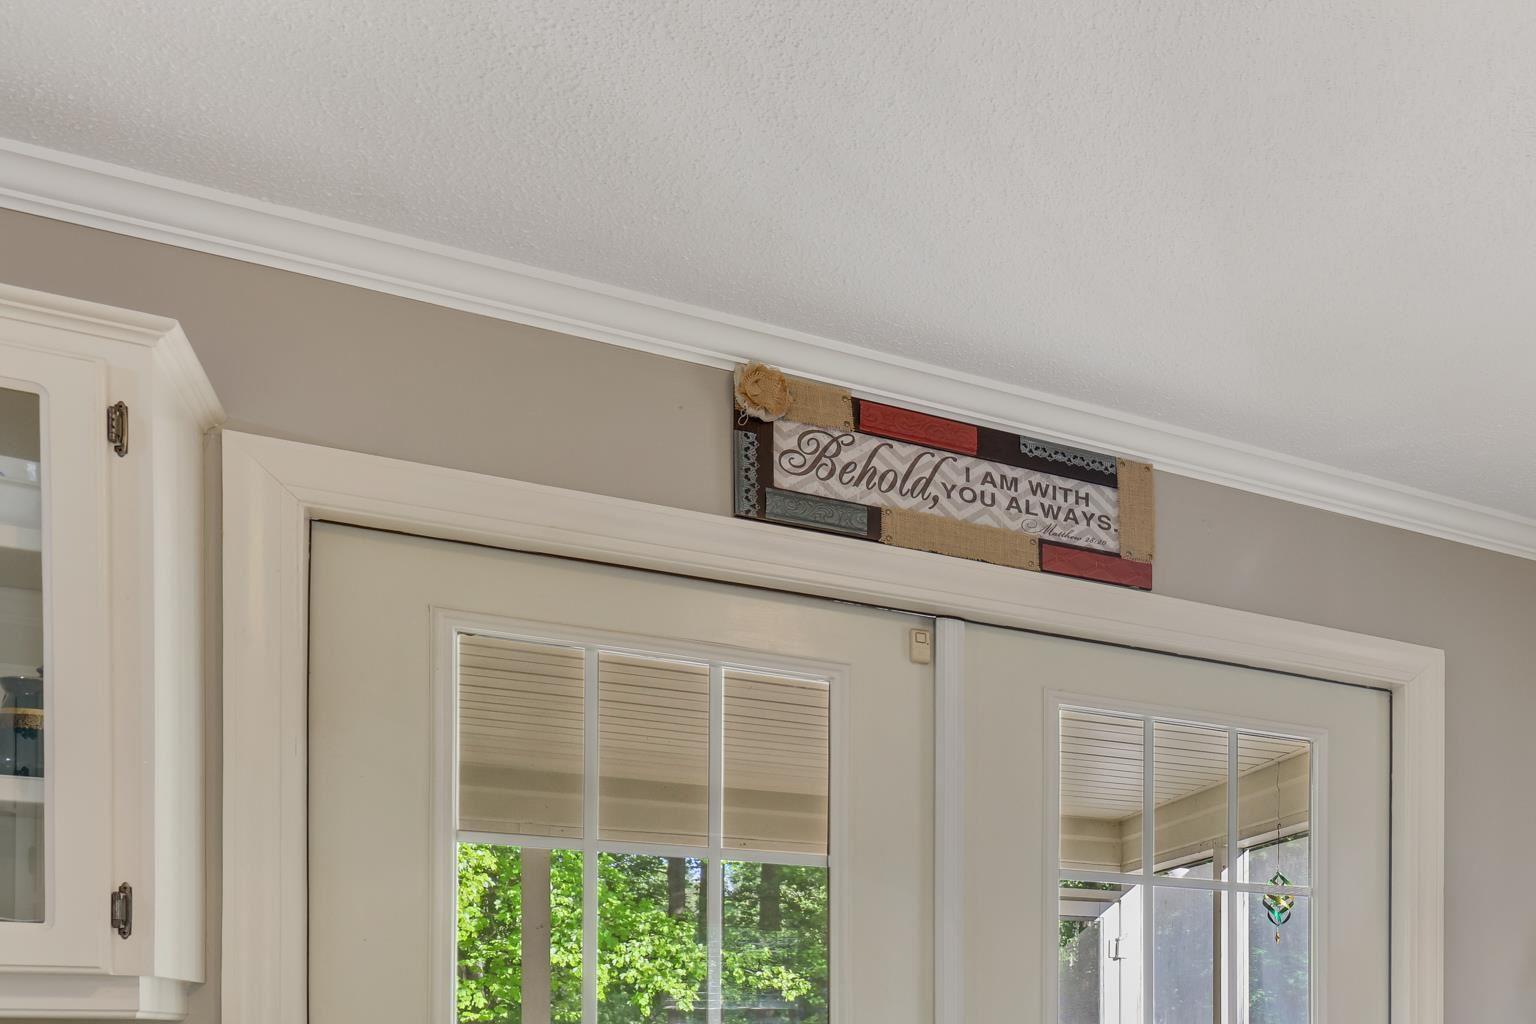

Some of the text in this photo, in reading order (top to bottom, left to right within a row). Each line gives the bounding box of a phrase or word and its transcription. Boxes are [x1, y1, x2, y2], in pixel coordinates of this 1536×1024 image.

[778, 429, 957, 510] Behold,
[965, 466, 1091, 507] I AM WITH
[941, 481, 1118, 532] YOU ALWAYS.
[1021, 518, 1082, 542] Matthew
